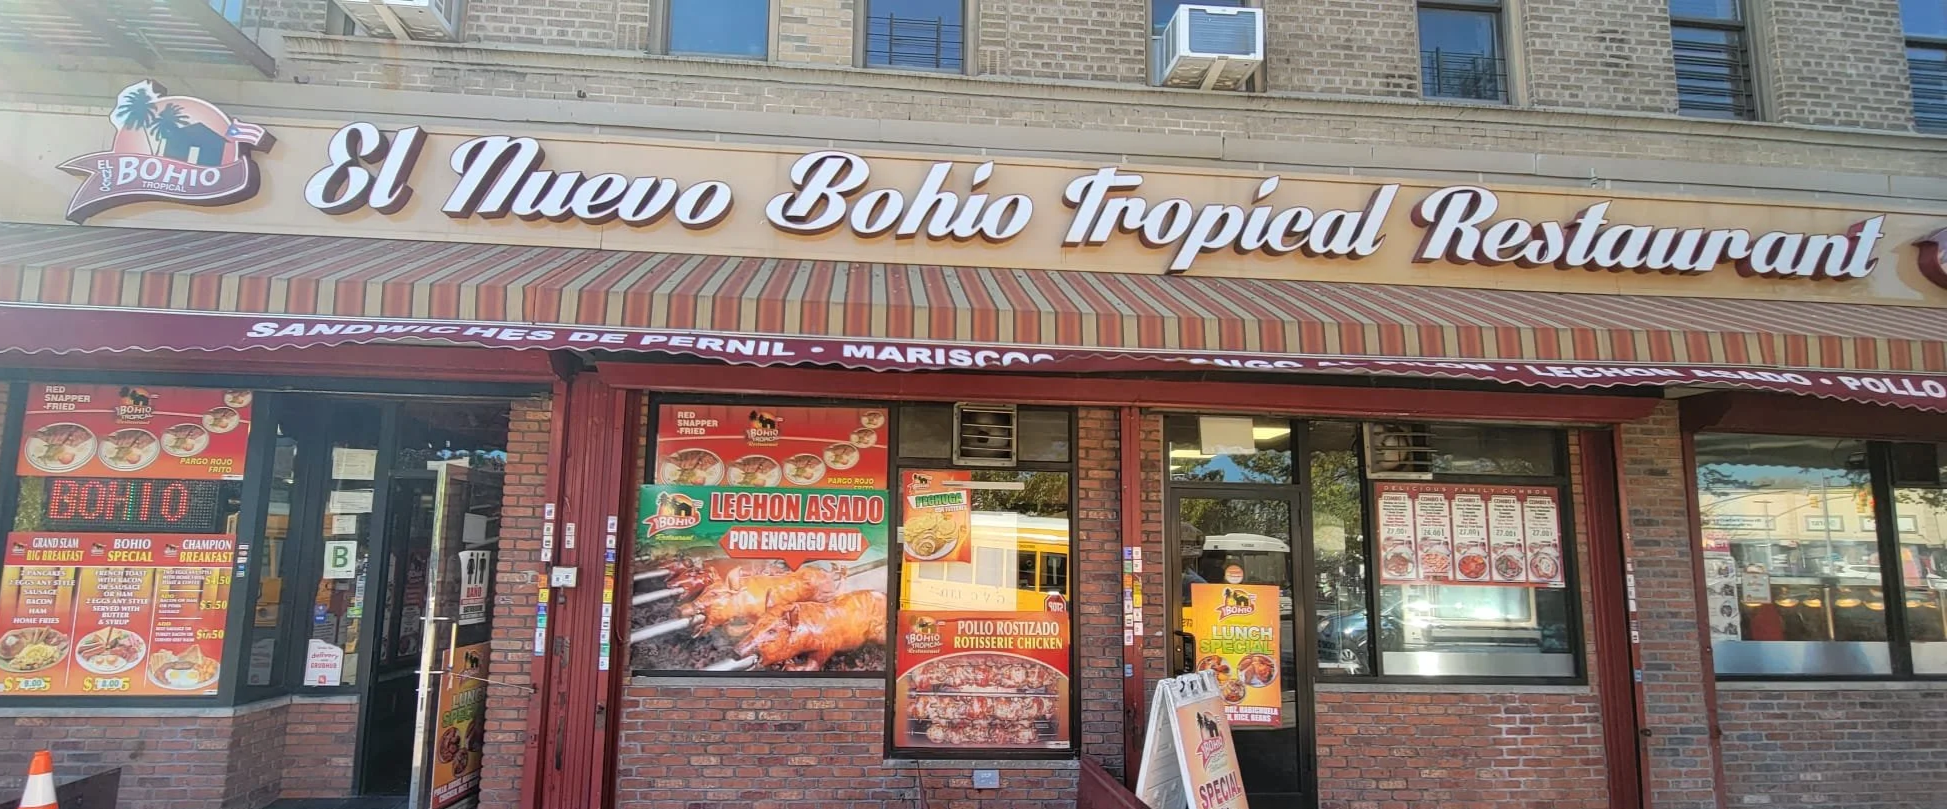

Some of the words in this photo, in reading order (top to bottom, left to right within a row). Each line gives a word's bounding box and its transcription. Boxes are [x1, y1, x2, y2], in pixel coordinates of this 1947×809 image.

[97, 159, 113, 169] EL
[116, 156, 220, 187] BOHIO
[142, 180, 187, 193] TROPICAL
[304, 121, 424, 214] El
[441, 134, 733, 229] Nuevo
[765, 150, 1033, 239] Bohio
[1061, 166, 1400, 274] Tropical
[1412, 185, 1886, 280] Restaurant
[247, 321, 555, 342] SANDWICHES
[568, 331, 627, 345] DE
[639, 332, 796, 357] PERNIL
[1524, 364, 1686, 378] LECHON
[1691, 368, 1812, 386] ASADO
[1836, 375, 1947, 399] POLLO
[45, 385, 66, 393] RED
[44, 393, 91, 403] SNAPPER
[120, 405, 152, 415] BOHIO
[677, 411, 696, 419] RED
[677, 419, 719, 427] SNAPPER
[180, 457, 209, 466] PARGO
[210, 458, 233, 466] ROJO
[208, 466, 232, 474] FRITO
[827, 477, 853, 485] PARGO
[48, 480, 189, 521] BOHIO
[709, 492, 802, 522] LECHON
[804, 495, 884, 524] ASADO
[659, 516, 696, 528] BOHIO
[32, 537, 58, 549] GRAND
[60, 538, 79, 549] SLAM
[114, 539, 152, 550] BOHIO
[182, 539, 232, 550] CHAMPION
[729, 530, 759, 550] POR
[761, 530, 826, 551] ENCARGO
[828, 532, 862, 552] AQUI
[26, 550, 41, 562] BIG
[42, 551, 84, 562] BREAKFAST
[107, 551, 154, 563] SPECIAL
[179, 551, 234, 563] BREAKFAST
[332, 545, 348, 568] B
[957, 620, 994, 636] POLLO
[996, 621, 1059, 636] ROSTIZADO
[1212, 625, 1273, 641] LUNCH
[910, 633, 940, 642] BOHIO
[954, 636, 1014, 649] ROTISSERIE
[1017, 637, 1063, 650] CHICKEN
[1200, 639, 1274, 655] SPECIAL
[1199, 771, 1242, 809] SPECIAL
